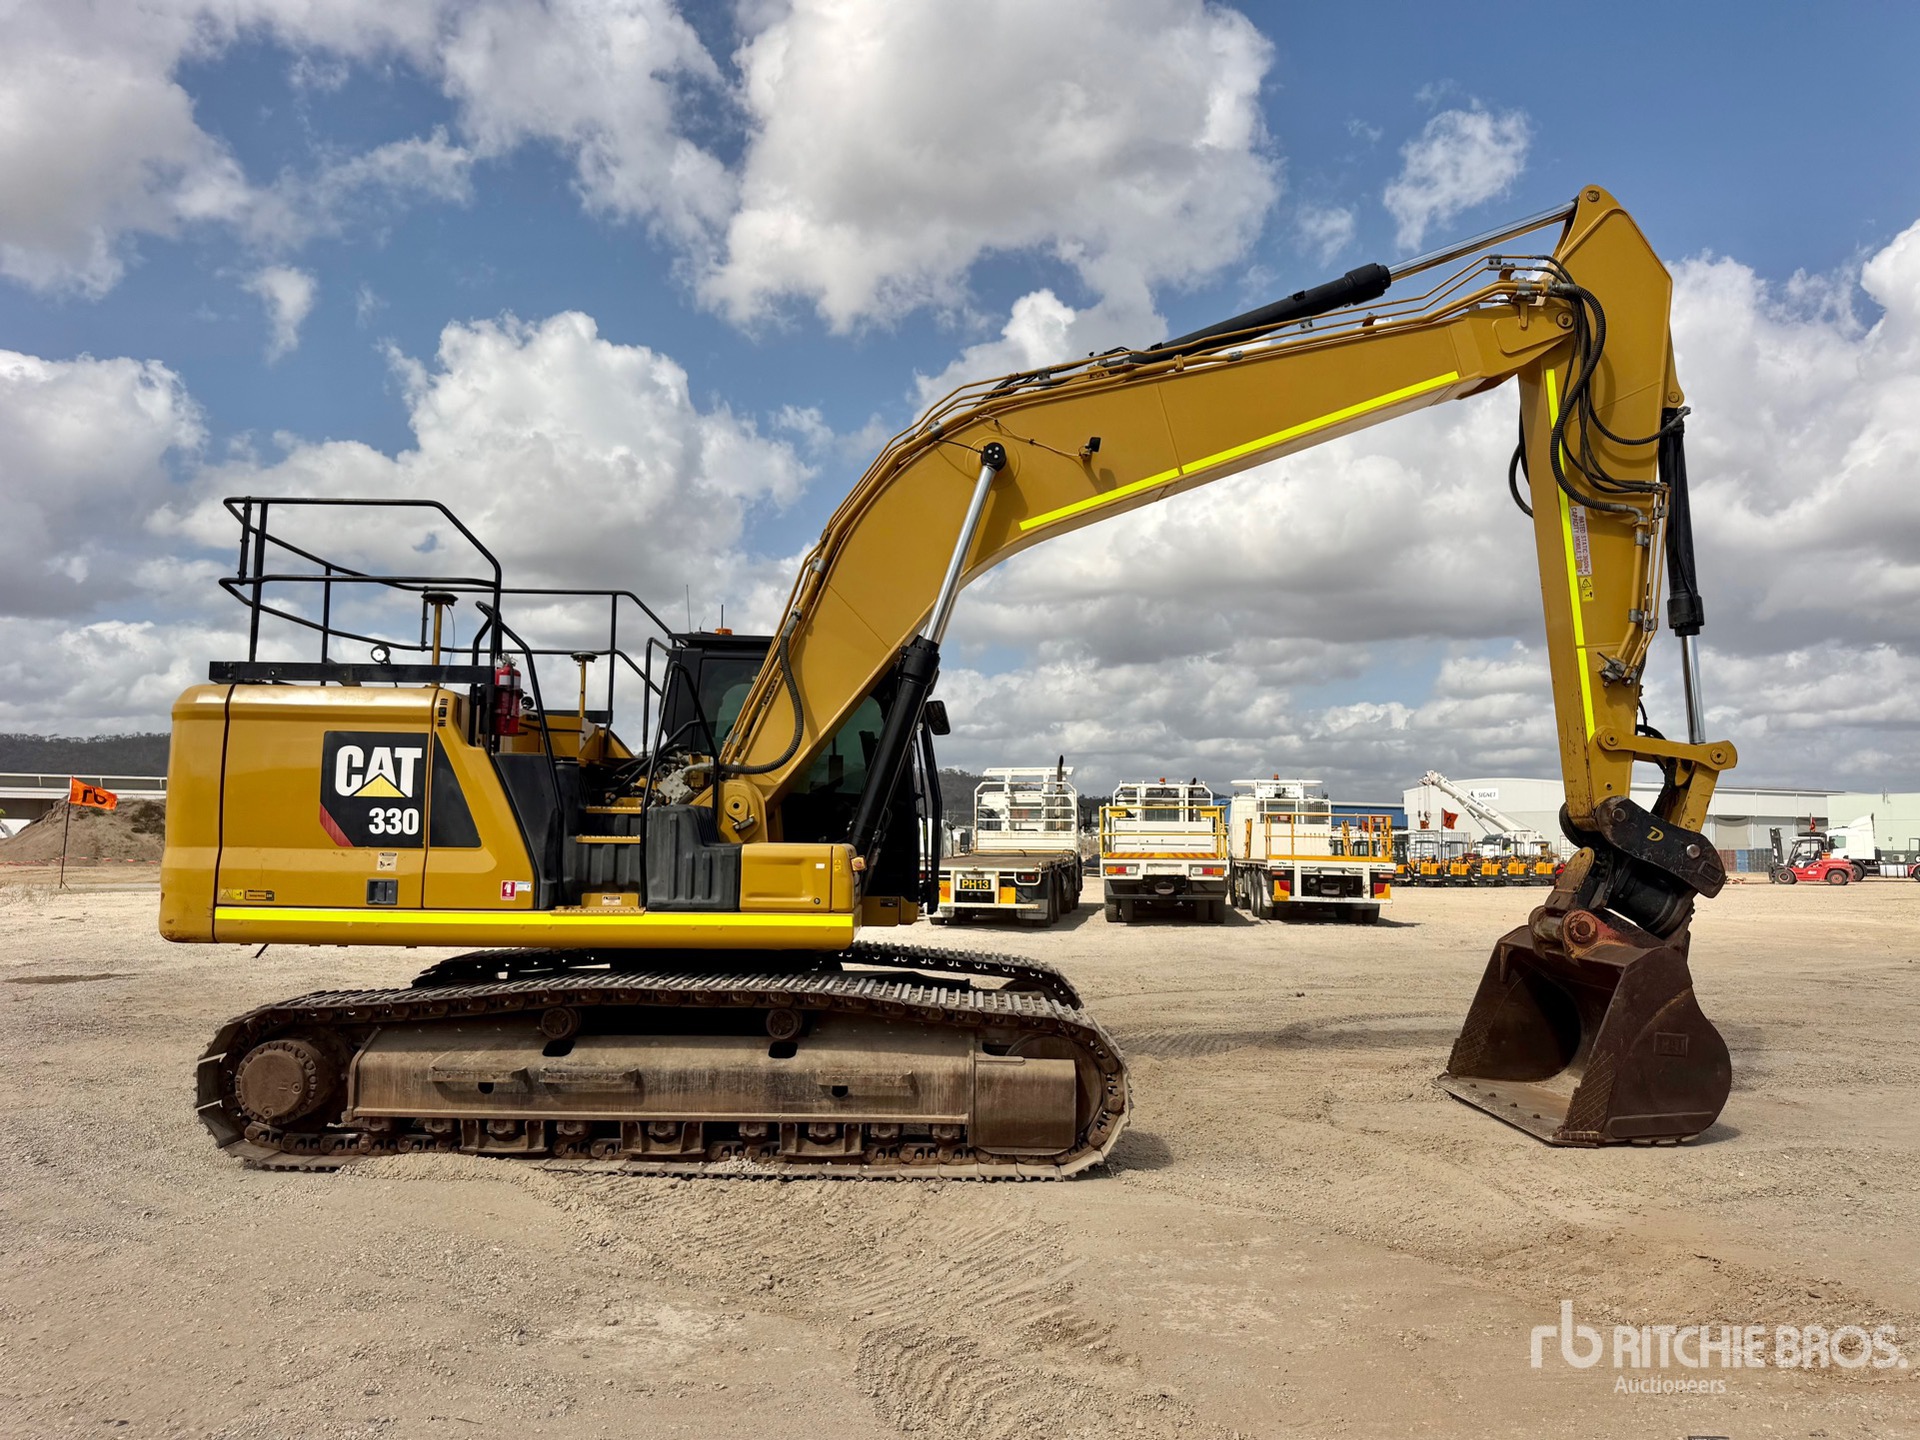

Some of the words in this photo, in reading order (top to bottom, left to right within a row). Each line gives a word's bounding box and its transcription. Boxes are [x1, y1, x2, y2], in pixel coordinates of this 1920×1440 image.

[335, 745, 422, 798] CAT
[82, 787, 107, 805] rb
[368, 807, 419, 835] 330
[961, 880, 989, 889] PH13
